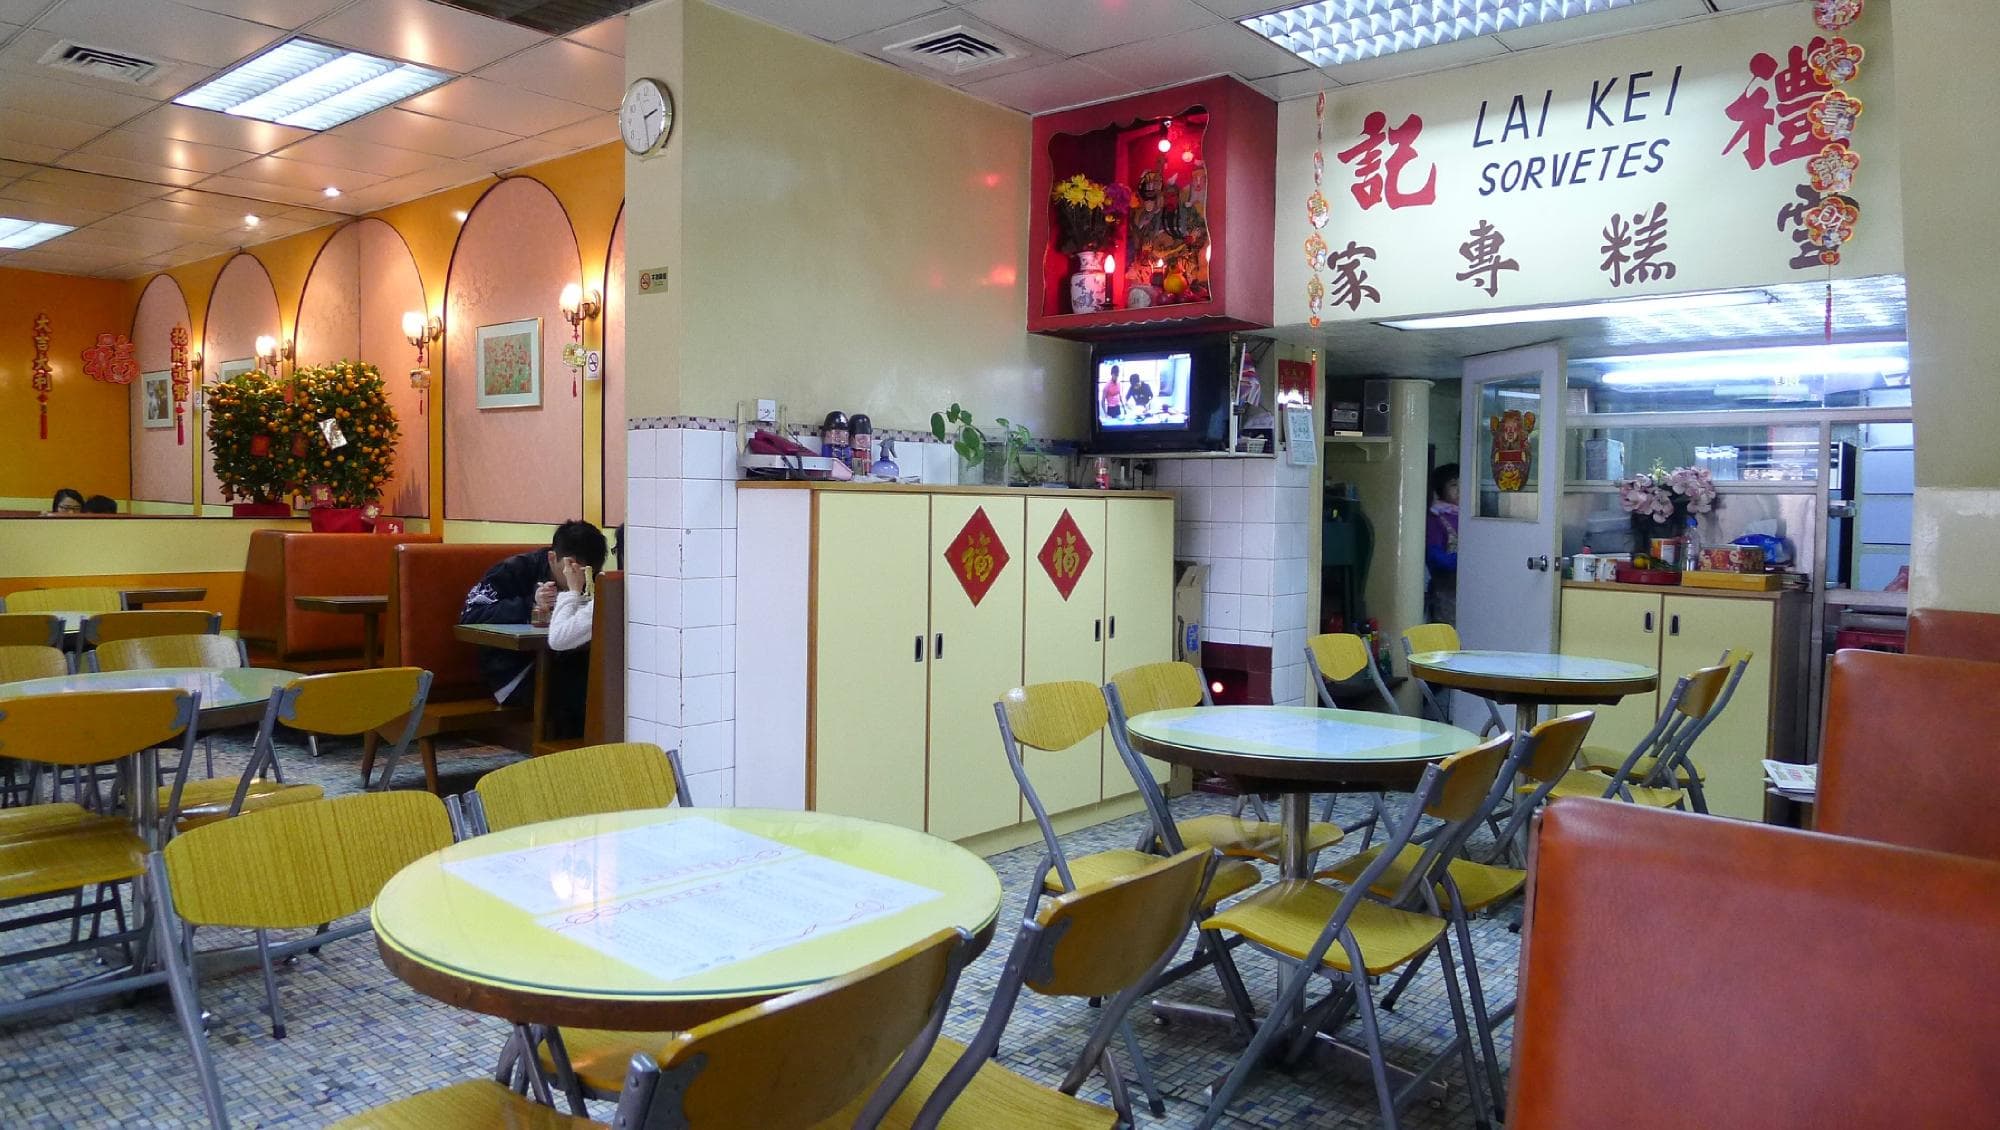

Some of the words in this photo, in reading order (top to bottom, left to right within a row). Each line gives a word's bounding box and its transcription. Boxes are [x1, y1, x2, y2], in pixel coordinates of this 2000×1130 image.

[1473, 89, 1552, 148] LAI
[1586, 65, 1682, 130] KEI
[1338, 111, 1436, 210] 記
[1478, 138, 1671, 196] SORVETES
[33, 314, 53, 392] 大吉大利
[961, 530, 995, 582] 福
[1052, 530, 1080, 579] 福
